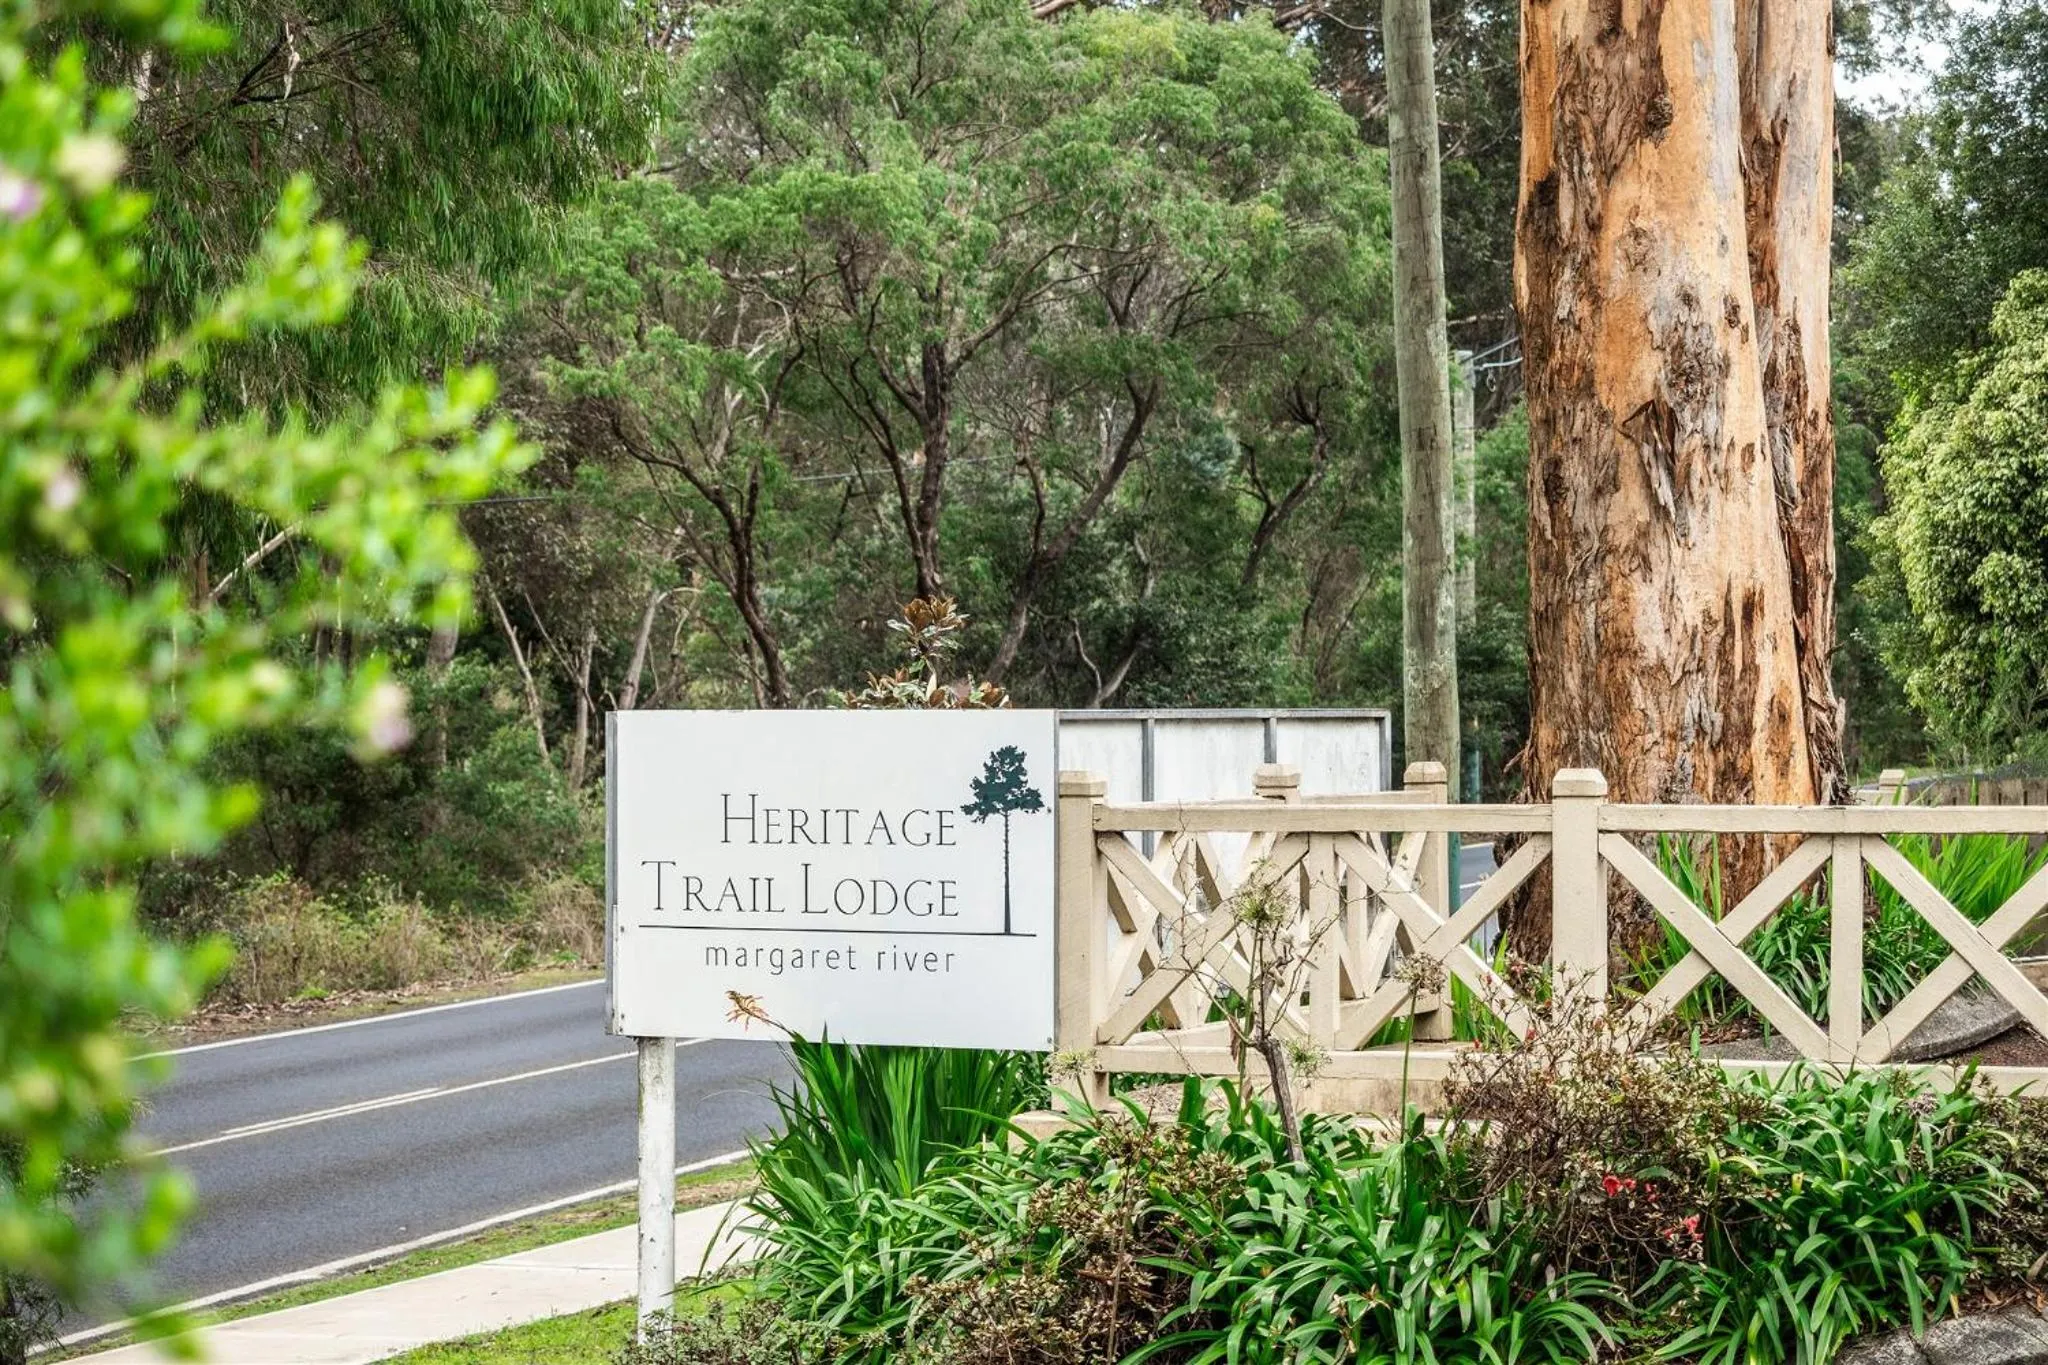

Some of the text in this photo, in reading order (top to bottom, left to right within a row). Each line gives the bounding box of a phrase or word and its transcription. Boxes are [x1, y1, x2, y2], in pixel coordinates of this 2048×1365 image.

[720, 792, 957, 847] HERITAGE
[640, 859, 960, 918] TRAIL LODGE
[705, 944, 956, 975] margaret river
